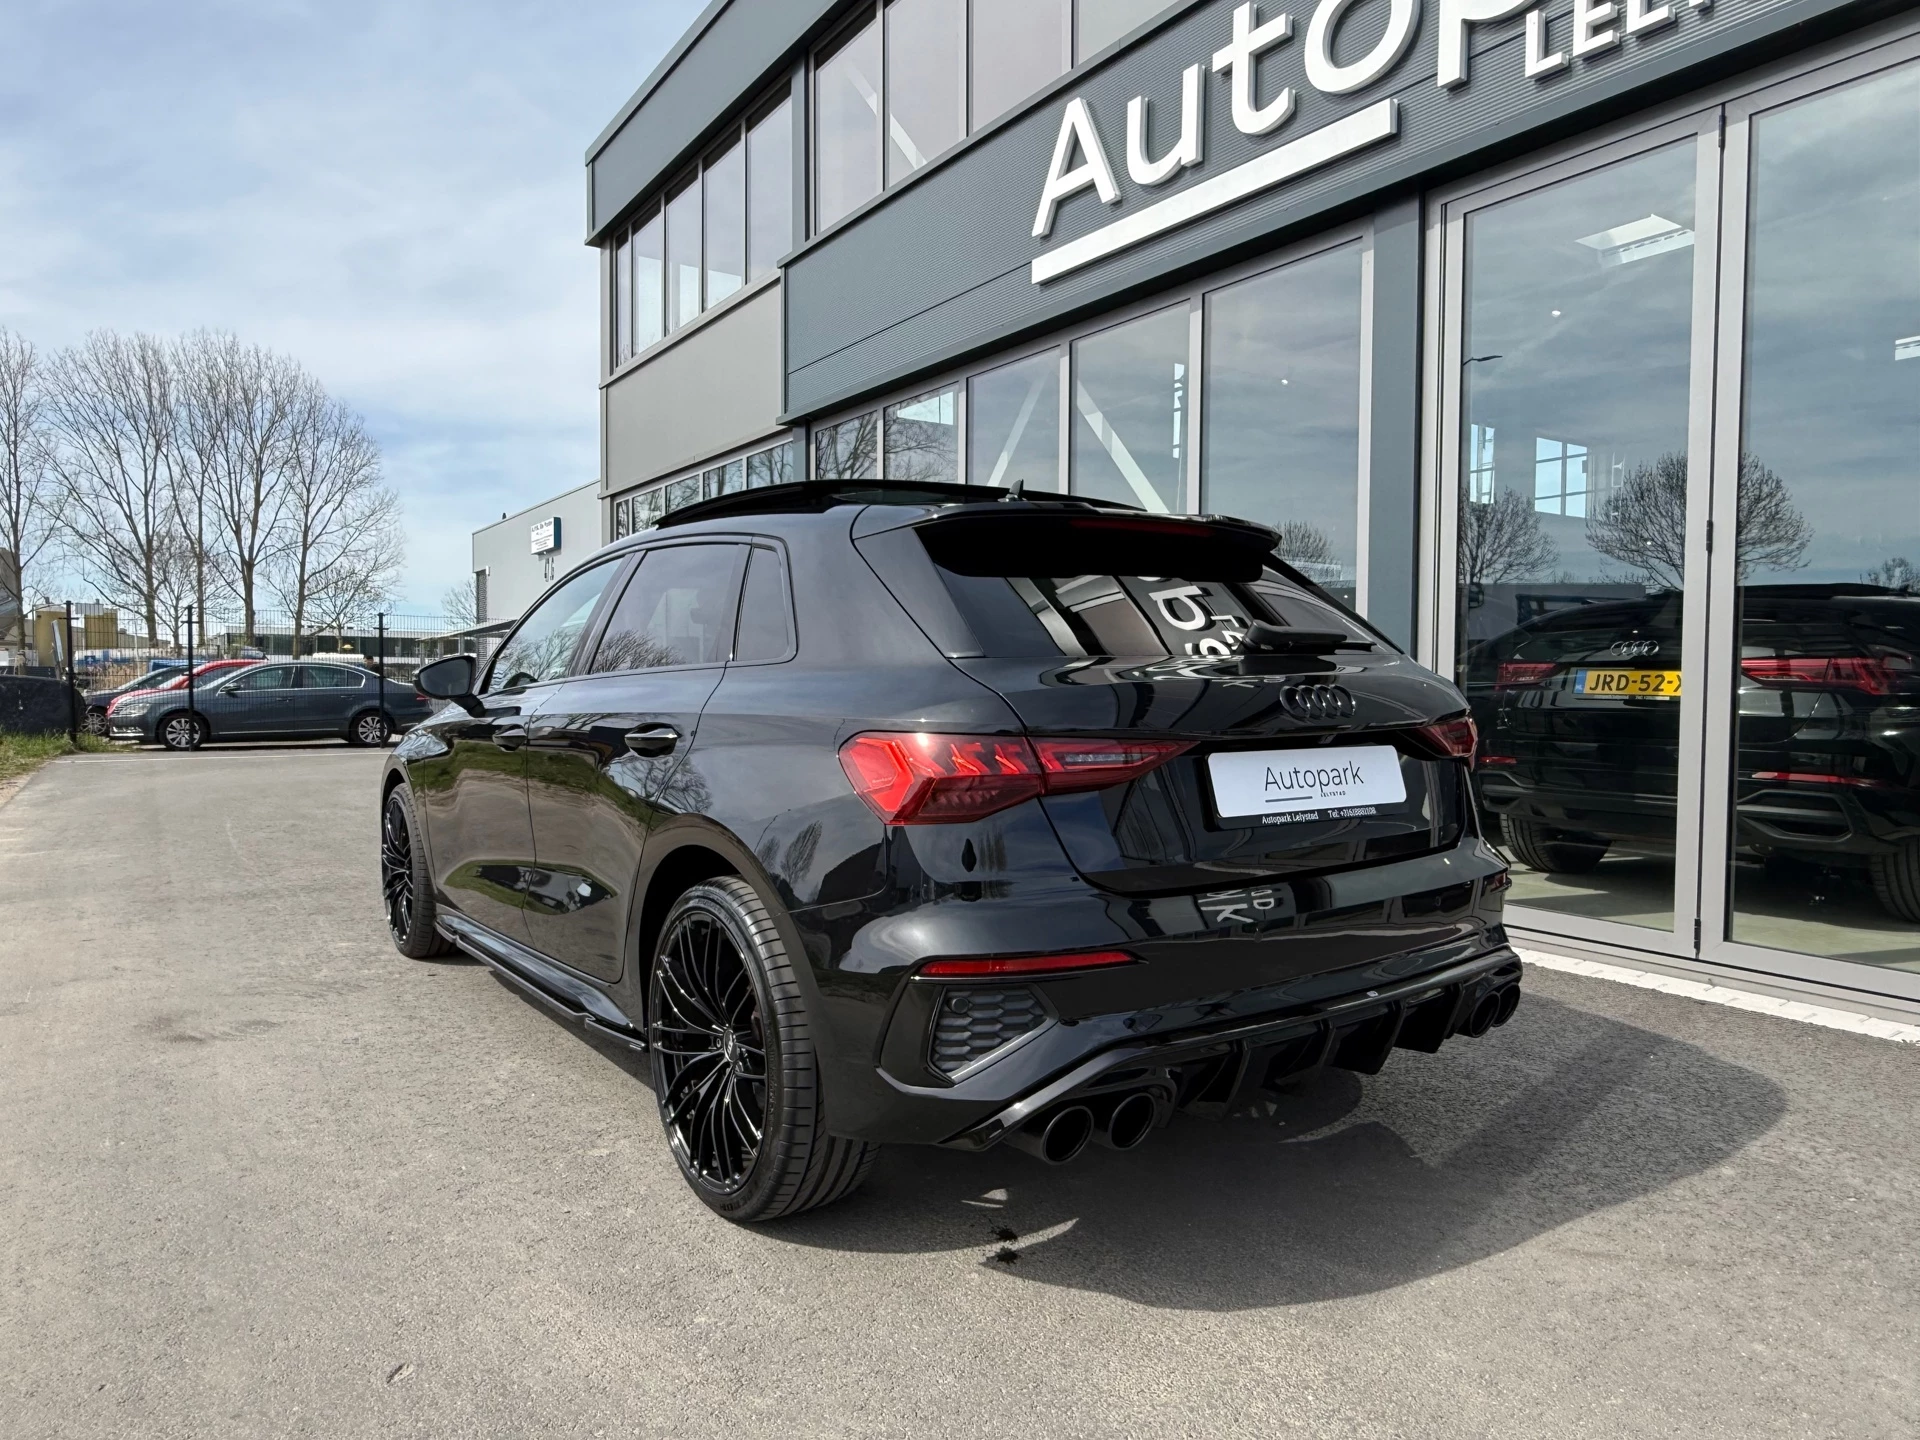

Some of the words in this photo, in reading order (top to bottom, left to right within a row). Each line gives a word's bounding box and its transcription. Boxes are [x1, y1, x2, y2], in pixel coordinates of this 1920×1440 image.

[1525, 0, 1715, 79] LEL
[1264, 760, 1364, 793] Autopark
[1261, 813, 1292, 825] Autopark
[1292, 811, 1319, 823] Lelystad
